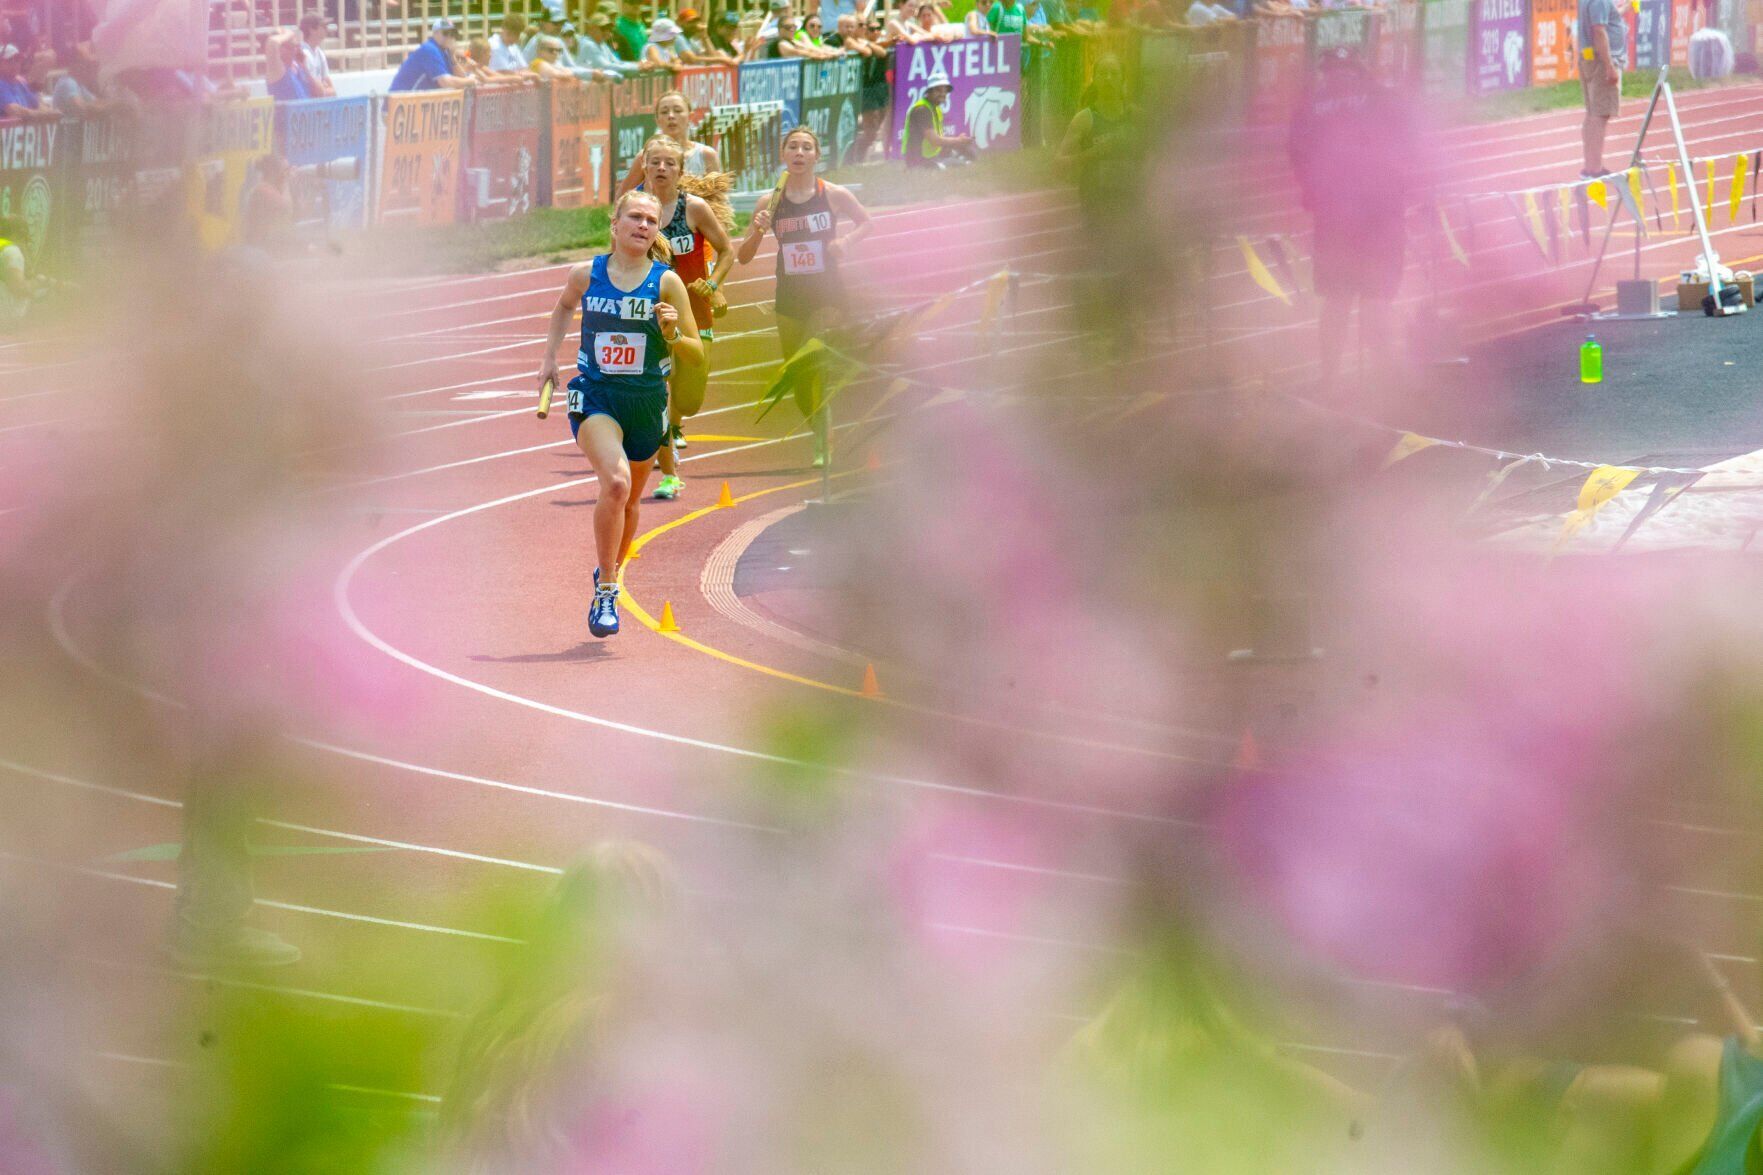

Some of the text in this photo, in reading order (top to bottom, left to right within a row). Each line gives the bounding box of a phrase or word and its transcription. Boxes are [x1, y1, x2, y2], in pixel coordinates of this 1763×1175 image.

[908, 40, 1010, 81] AXTELL
[682, 71, 732, 110] AURORA
[393, 100, 460, 144] GILTNER
[1, 123, 57, 169] VERLY
[390, 152, 421, 189] 2017
[811, 214, 828, 231] 10
[676, 236, 690, 253] 12
[790, 252, 816, 268] 148
[628, 298, 645, 319] 14
[602, 346, 635, 365] 320
